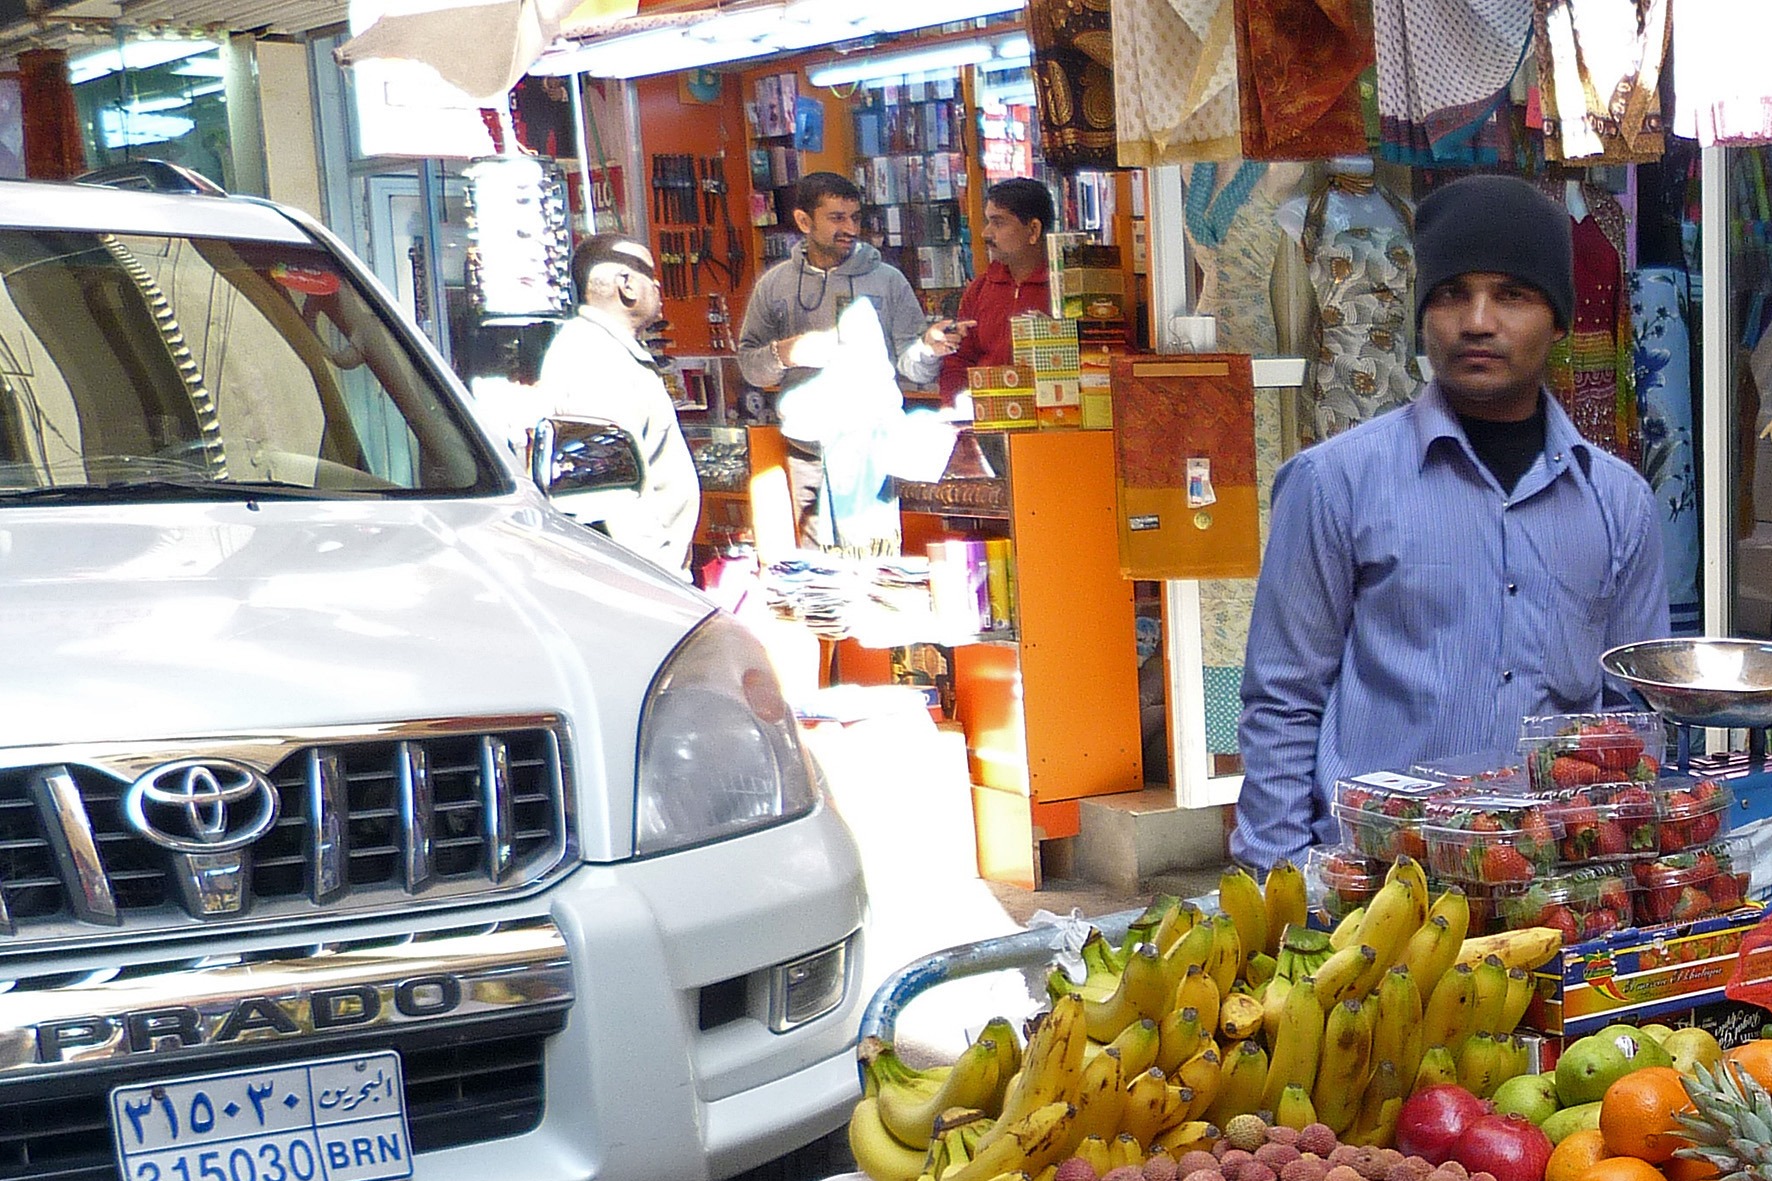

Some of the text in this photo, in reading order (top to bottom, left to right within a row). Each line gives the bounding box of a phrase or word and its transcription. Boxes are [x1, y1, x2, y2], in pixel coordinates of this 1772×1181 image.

[36, 973, 464, 1063] PRADO
[319, 1068, 393, 1110] البحرين
[327, 1133, 402, 1171] BRN
